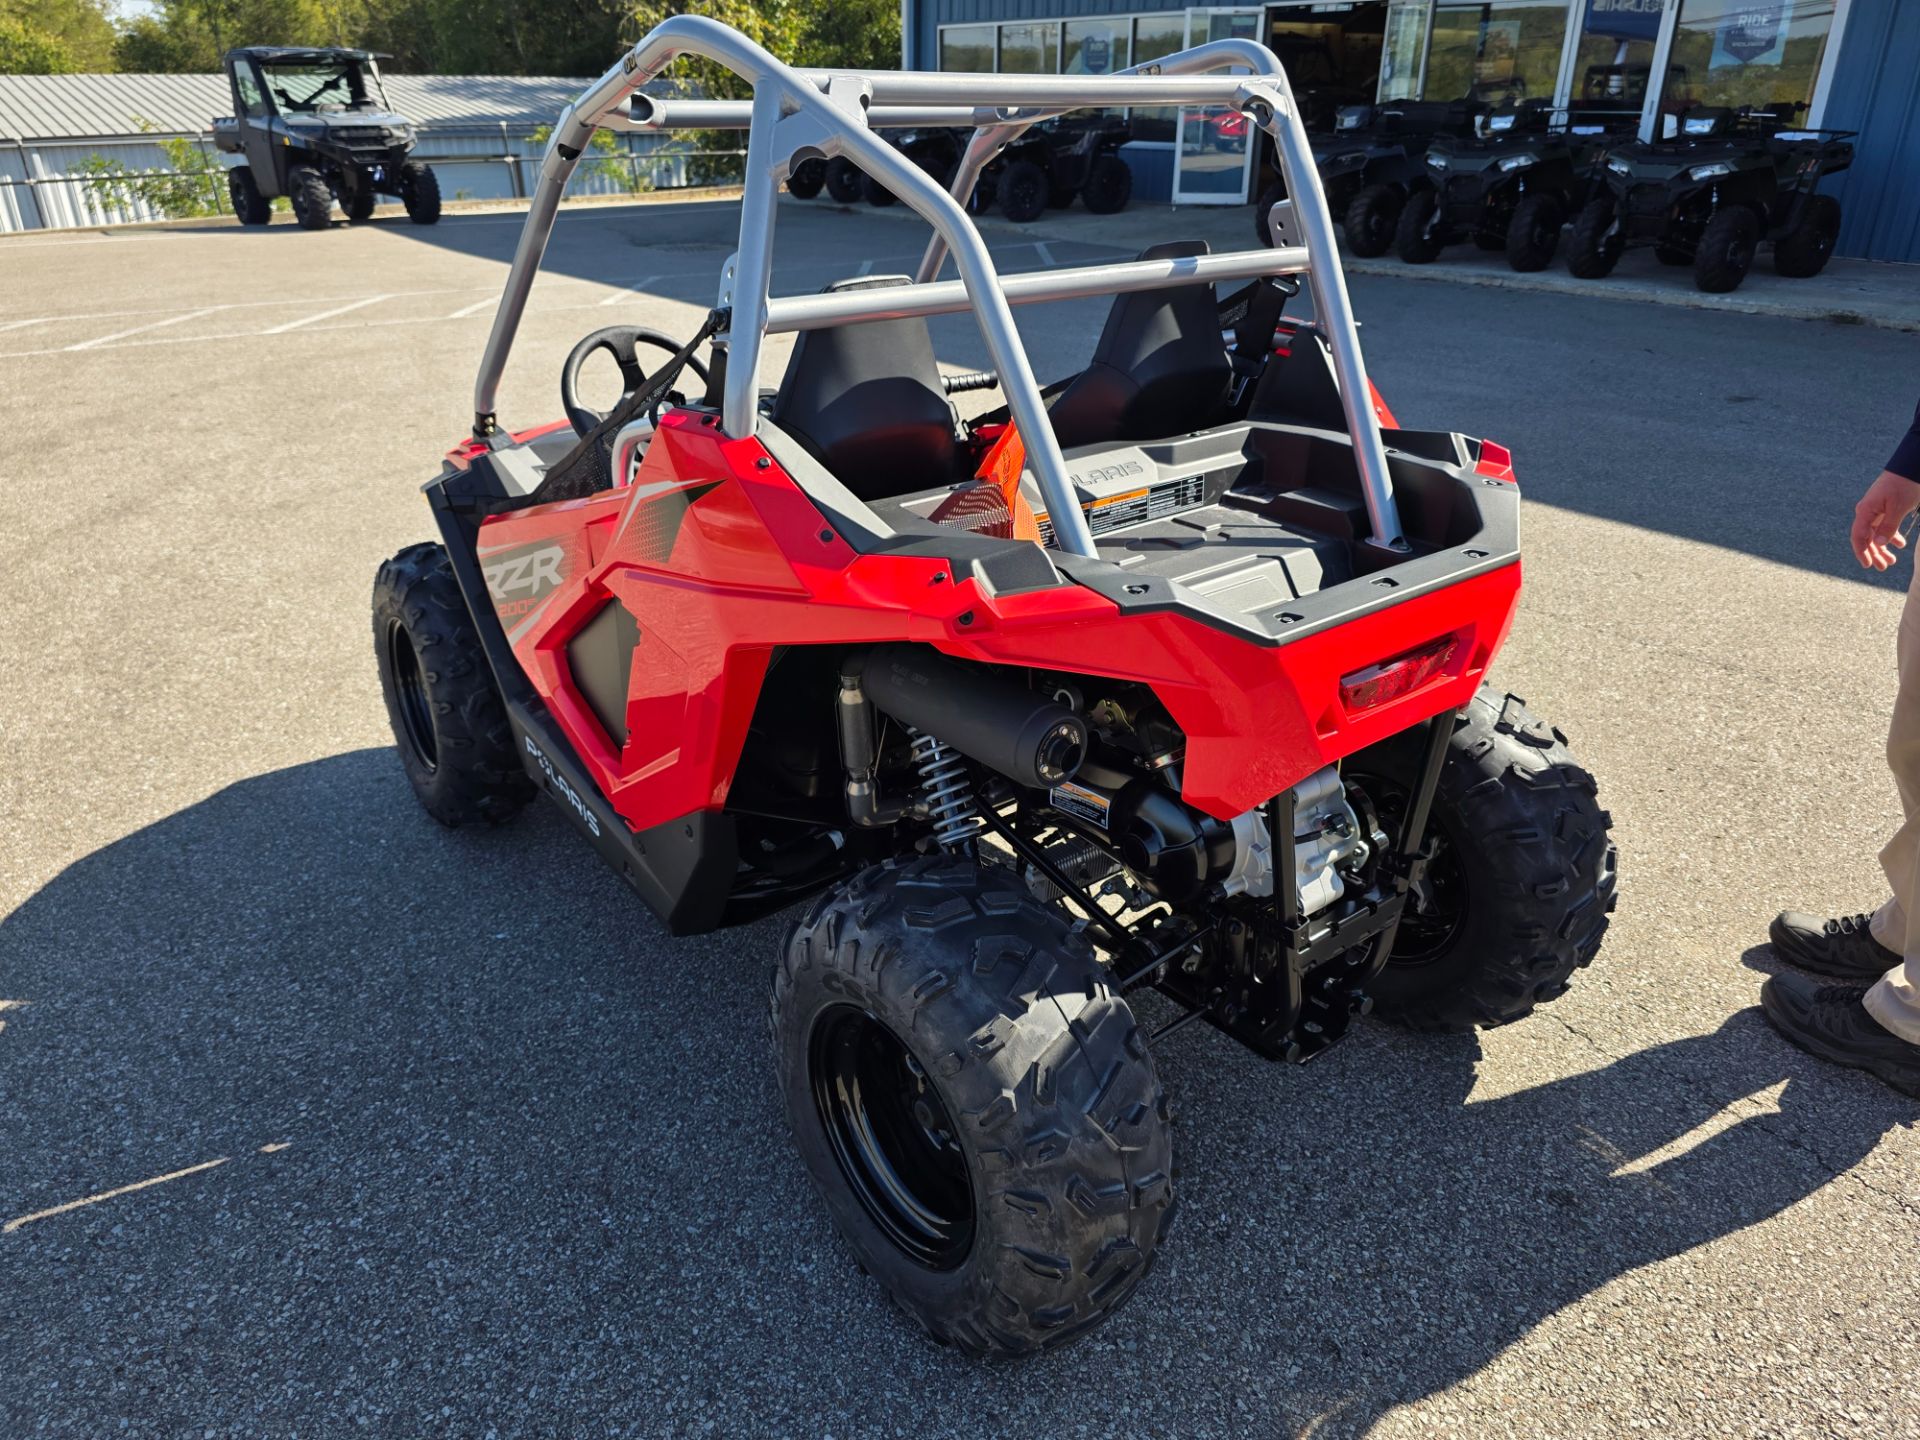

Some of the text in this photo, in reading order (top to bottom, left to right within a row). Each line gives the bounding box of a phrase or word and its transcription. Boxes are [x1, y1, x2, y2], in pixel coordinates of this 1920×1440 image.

[1737, 14, 1772, 28] RIDE
[482, 545, 565, 600] RZR
[525, 735, 600, 837] POLARIS
